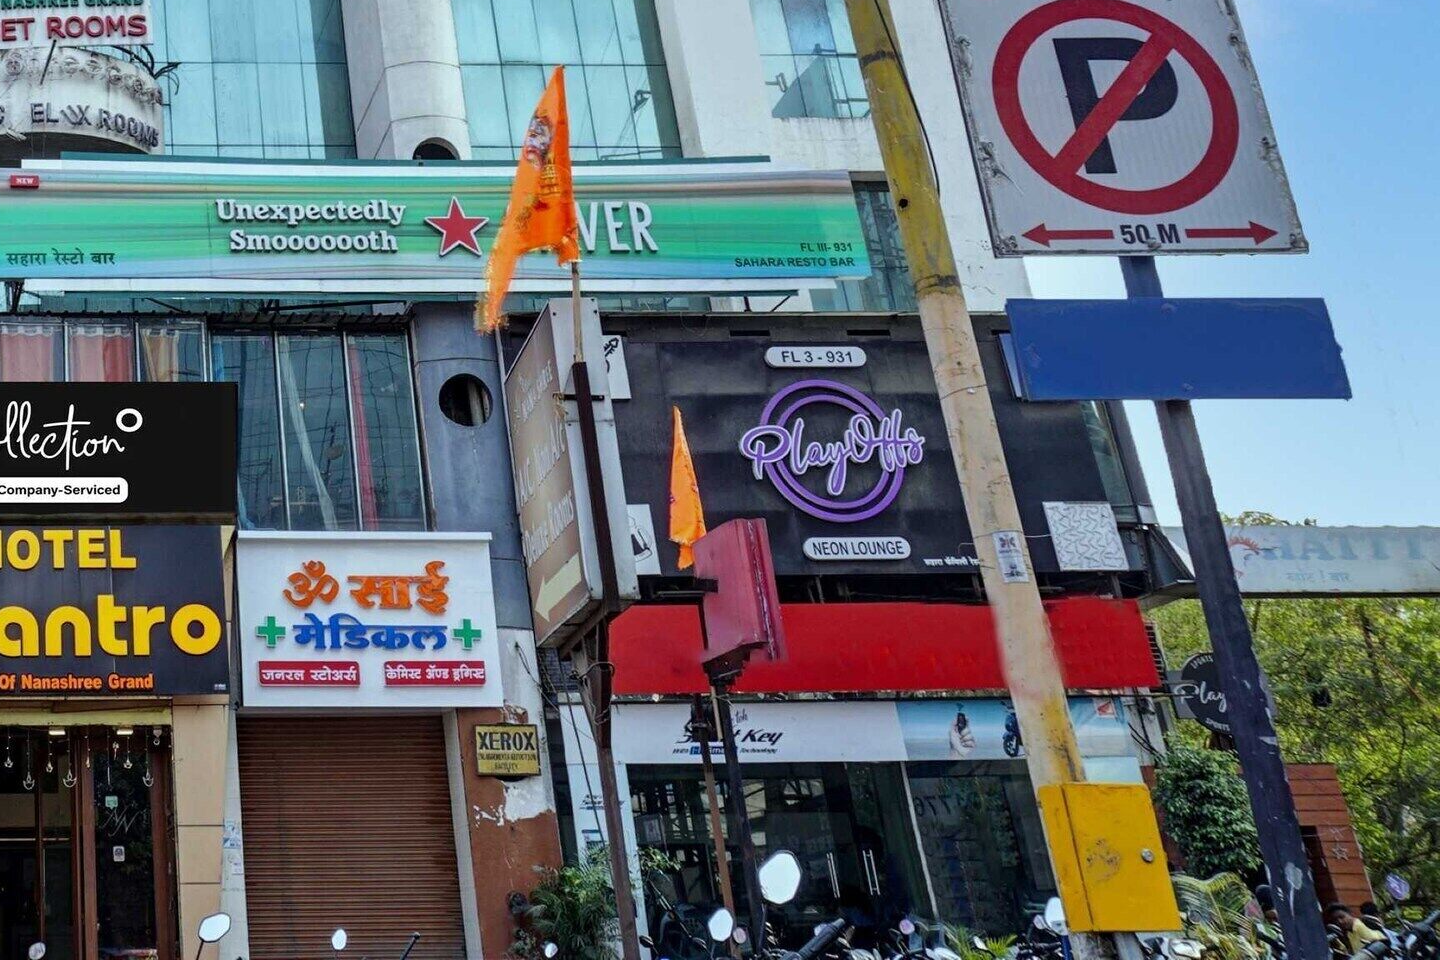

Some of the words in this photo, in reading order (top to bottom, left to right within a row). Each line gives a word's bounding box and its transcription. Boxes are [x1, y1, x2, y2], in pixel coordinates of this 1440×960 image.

[46, 14, 148, 40] ROOMS
[16, 177, 34, 185] NEW
[216, 199, 406, 226] Unexpectedly
[550, 200, 659, 252] VER
[1119, 224, 1151, 244] 50
[1158, 223, 1181, 244] M
[230, 229, 398, 252] Smooooooth
[800, 243, 814, 252] FL
[834, 243, 853, 251] 931
[6, 252, 47, 267] सहारा
[51, 247, 84, 265] रेस्टो
[90, 252, 115, 265] बार
[735, 258, 785, 267] SAHARA
[787, 258, 827, 267] RESTO
[830, 257, 855, 267] BAR
[781, 351, 800, 363] FL
[804, 351, 814, 362] 3
[826, 351, 853, 363] 931
[739, 408, 926, 496] PlayOffs
[812, 541, 846, 557] NEON
[850, 541, 904, 557] LOUNGE
[347, 561, 450, 615] साई
[293, 613, 448, 650] मेडिकल
[21, 674, 102, 691] Nanashree
[108, 673, 154, 690] Grand
[262, 670, 304, 680] जनरल
[310, 666, 357, 681] स्टोअर्स
[386, 666, 421, 679] केमिस्ट
[1174, 681, 1227, 713] Play
[478, 732, 535, 751] XEROX
[741, 729, 783, 745] Key
